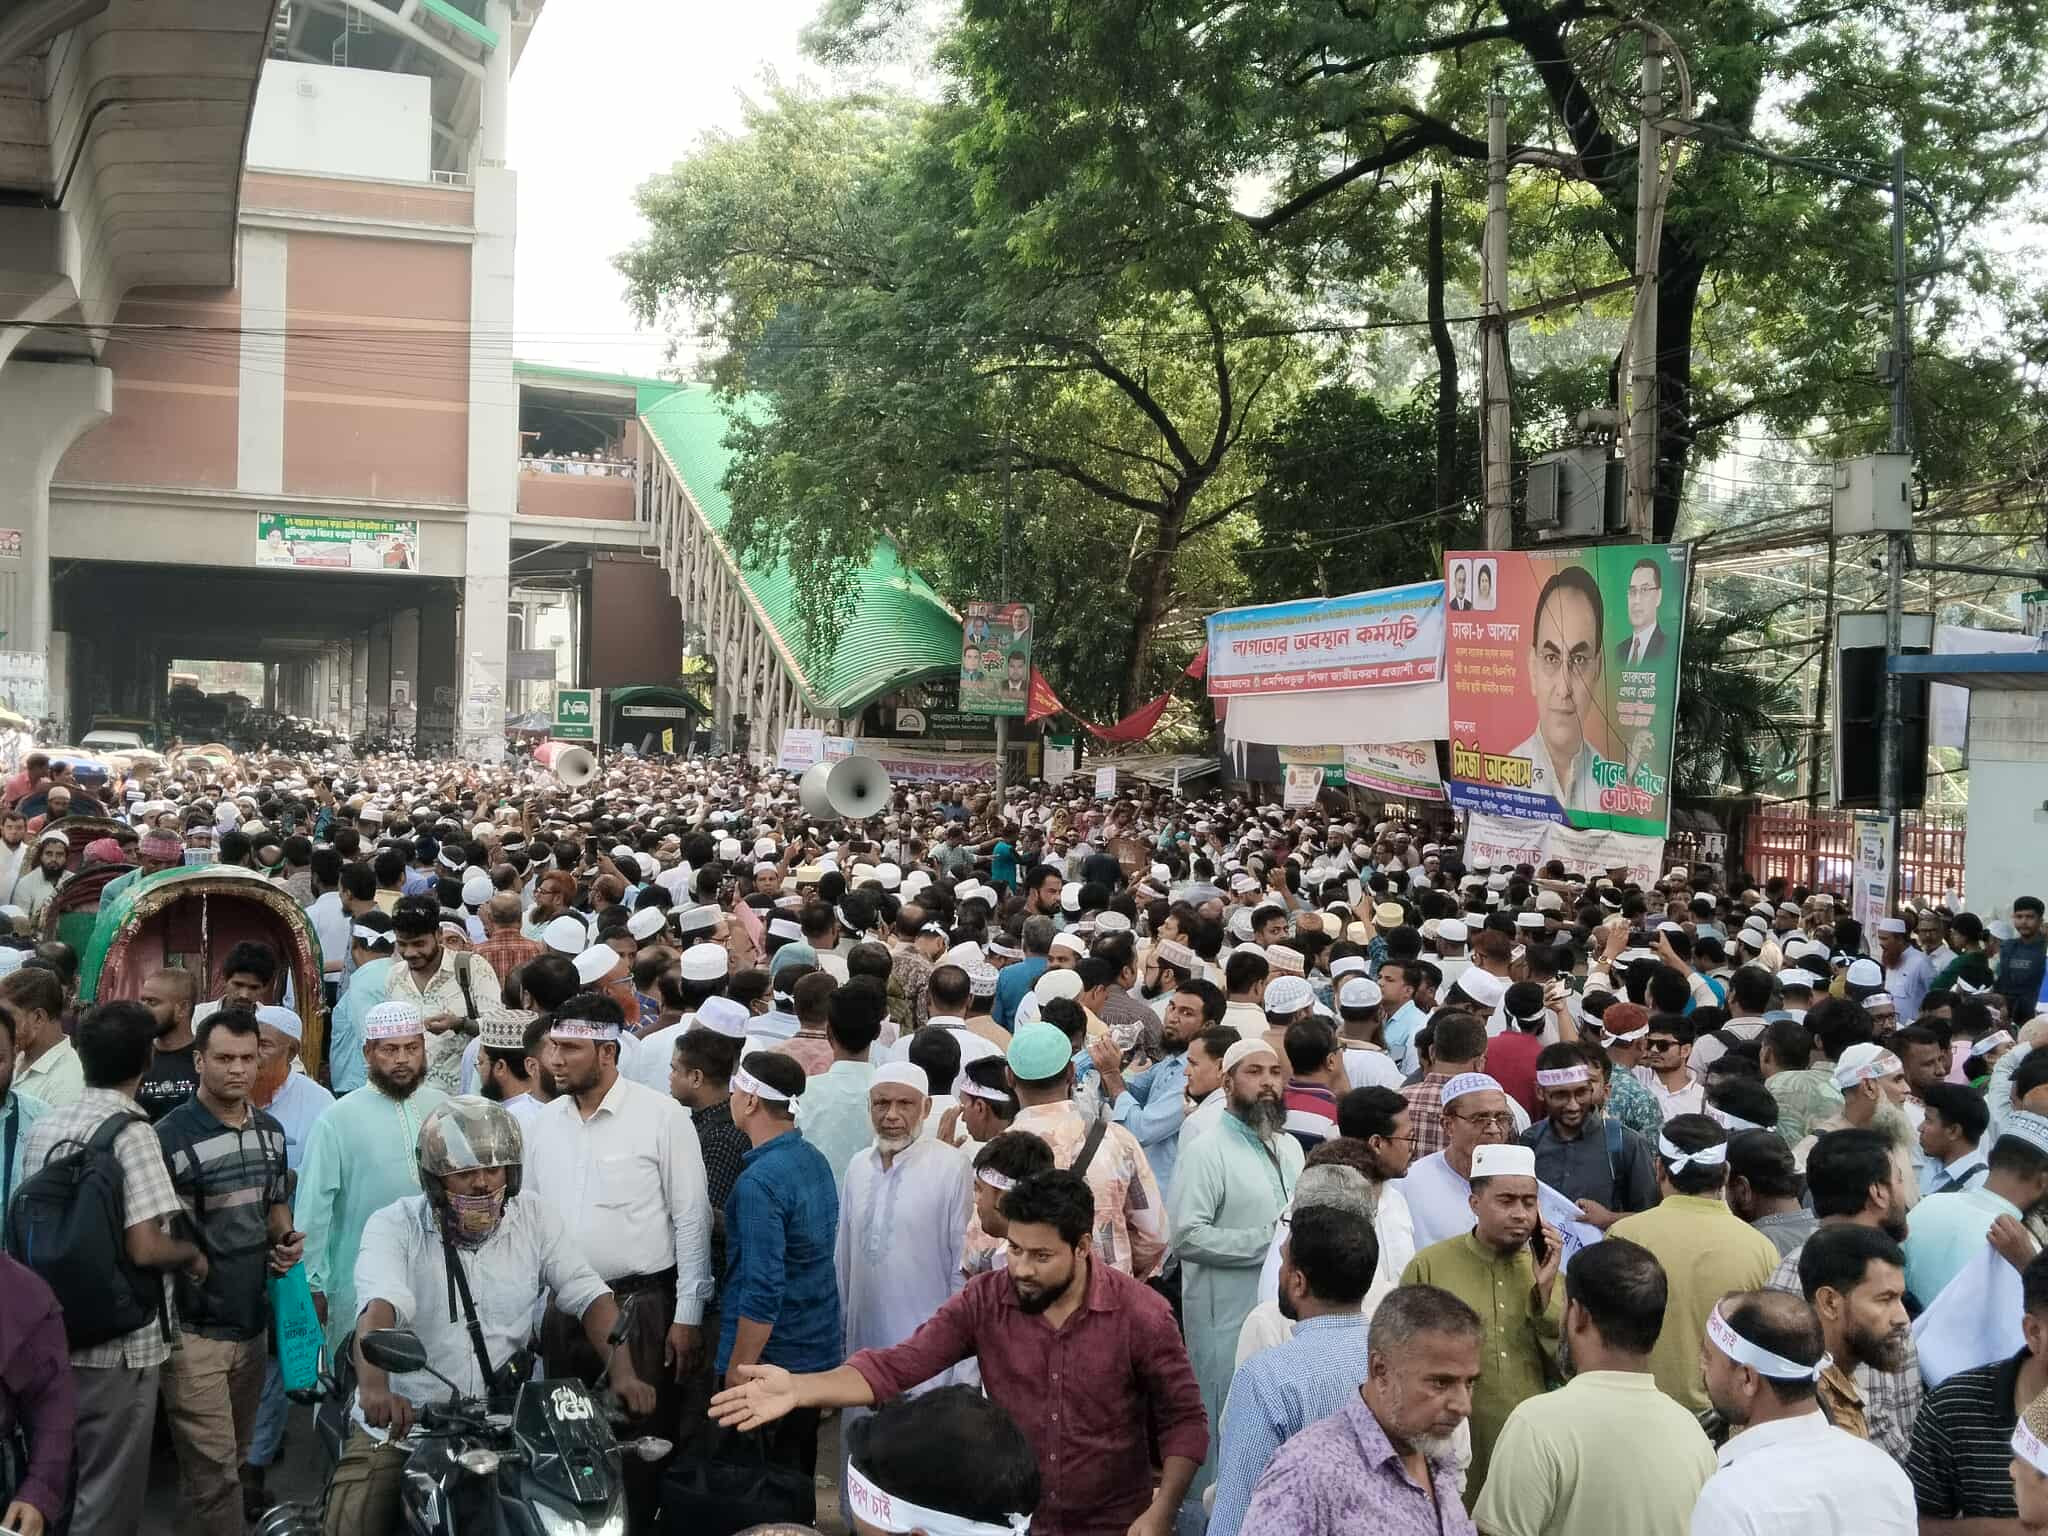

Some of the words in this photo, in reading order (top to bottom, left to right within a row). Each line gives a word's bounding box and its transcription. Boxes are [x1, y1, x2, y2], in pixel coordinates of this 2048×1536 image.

[1232, 636, 1288, 656] লাগাতার
[1294, 629, 1350, 651] অবস্থান
[1356, 615, 1420, 648] কর্মসূচি
[1452, 622, 1484, 640] ঢাকা-৮
[1487, 624, 1520, 641] আসনে
[1453, 738, 1481, 781] মির্জা
[1482, 752, 1532, 788] আব্বাস
[1592, 753, 1626, 788] ধানের
[871, 1493, 892, 1526] চাই
